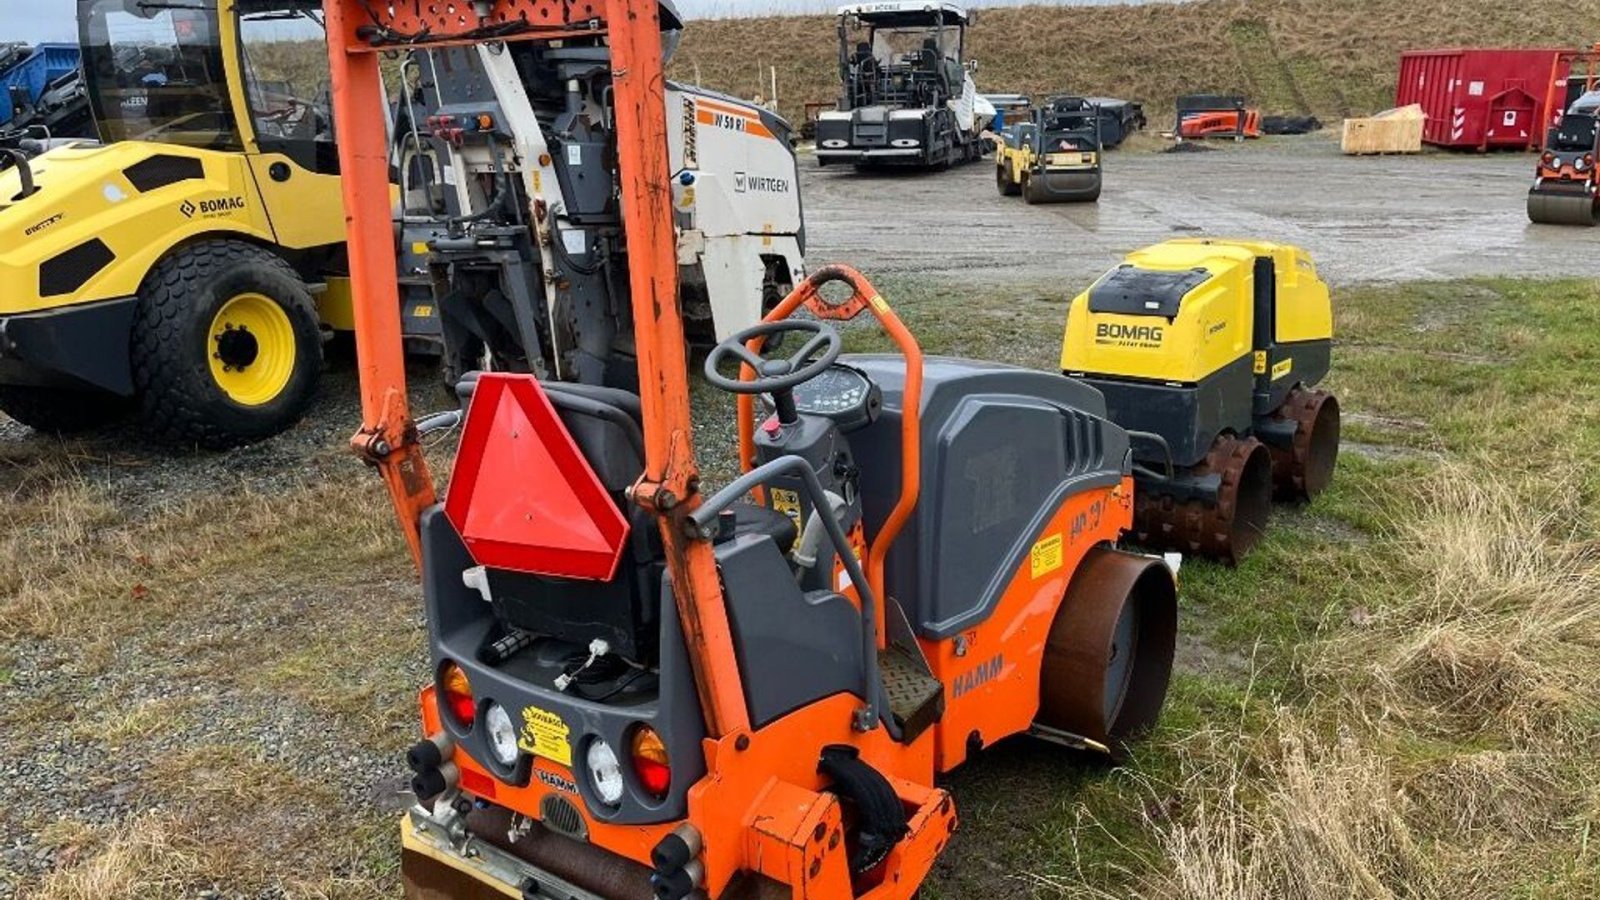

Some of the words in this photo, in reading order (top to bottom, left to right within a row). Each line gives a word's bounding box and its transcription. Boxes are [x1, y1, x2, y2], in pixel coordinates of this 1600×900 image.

[748, 176, 789, 192] WIRTGEN
[199, 196, 245, 213] BOMAG
[1096, 323, 1163, 341] BOMAG
[952, 652, 1003, 698] HAMM
[540, 771, 579, 794] HAMM
